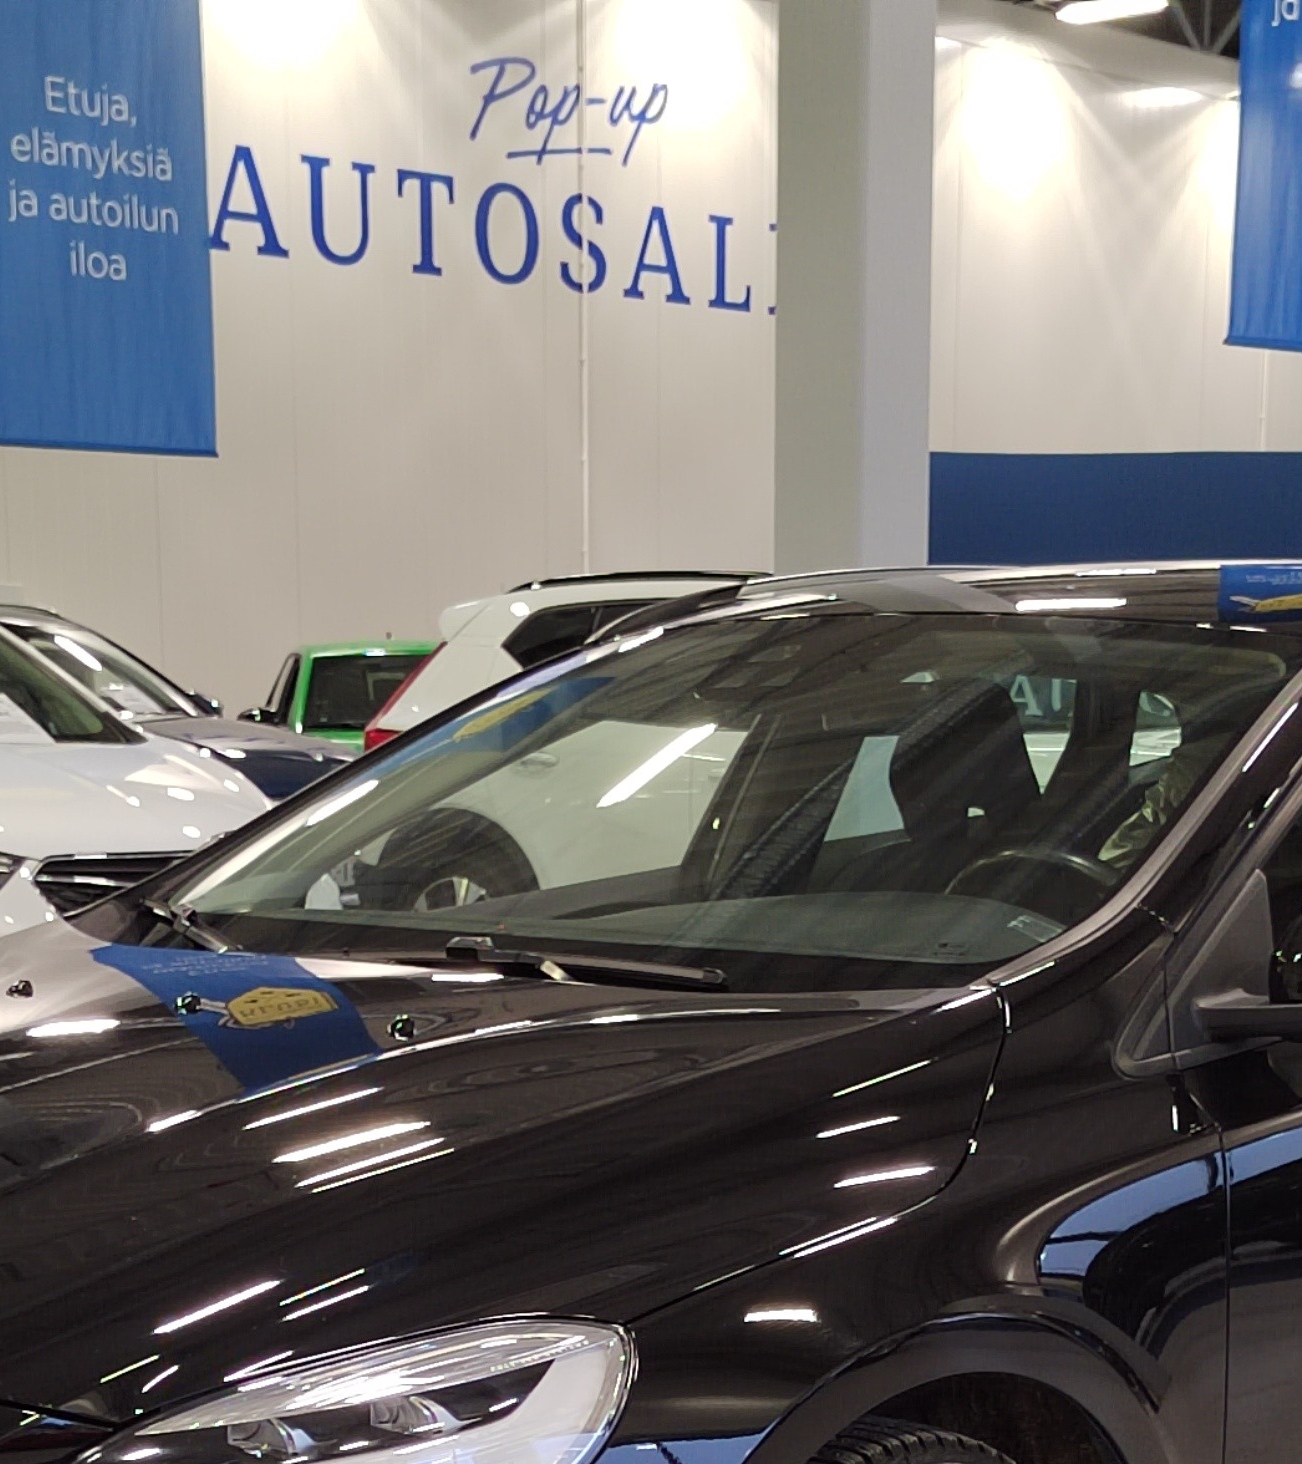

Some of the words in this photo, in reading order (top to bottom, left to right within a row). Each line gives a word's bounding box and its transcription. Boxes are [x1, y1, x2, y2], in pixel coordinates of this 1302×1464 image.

[44, 75, 137, 127] Etuja,
[470, 57, 668, 167] Pop-up
[10, 126, 173, 181] elämyksiä
[8, 178, 38, 222] ja
[49, 191, 179, 235] autoilun
[208, 144, 779, 317] AUTOSAL
[69, 240, 128, 281] iloa
